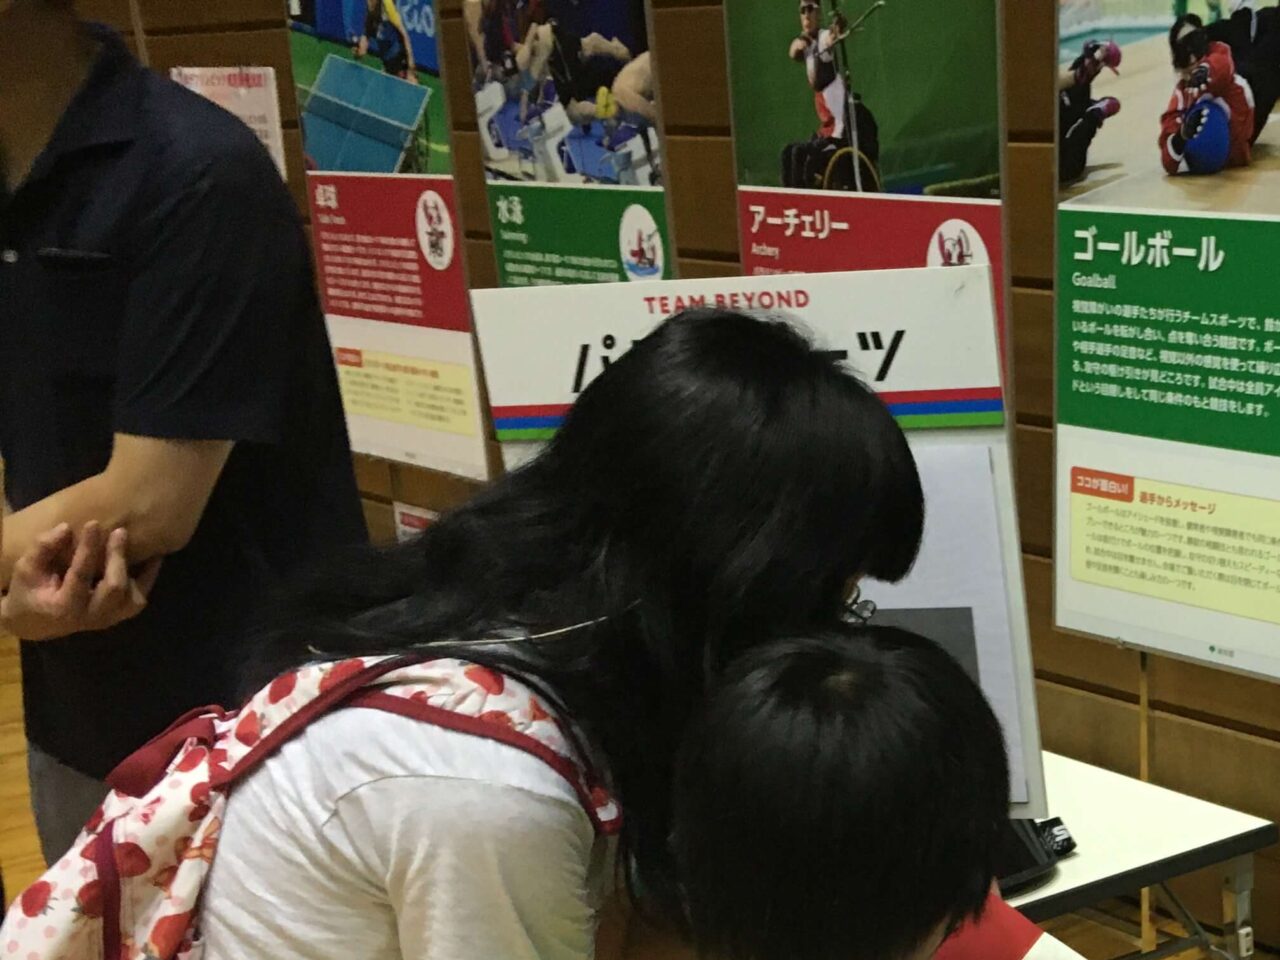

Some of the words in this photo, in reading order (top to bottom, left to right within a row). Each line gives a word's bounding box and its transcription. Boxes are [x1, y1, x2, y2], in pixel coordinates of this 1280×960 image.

[749, 205, 849, 239] アーチェリー
[1073, 225, 1225, 272] ゴールボール
[1072, 272, 1117, 289] Goalball
[643, 293, 705, 315] TEAM
[715, 290, 809, 311] BEYOND
